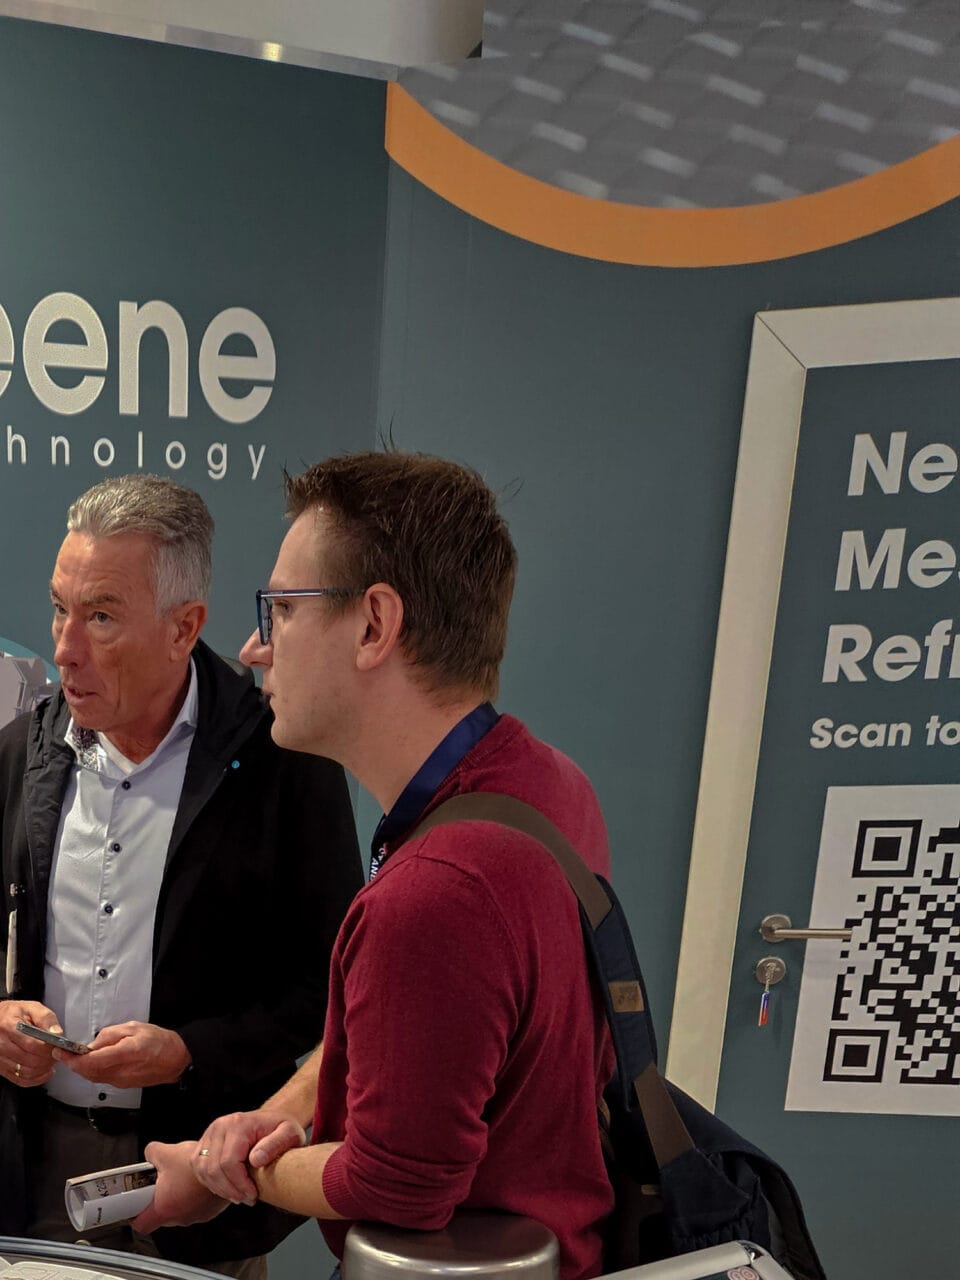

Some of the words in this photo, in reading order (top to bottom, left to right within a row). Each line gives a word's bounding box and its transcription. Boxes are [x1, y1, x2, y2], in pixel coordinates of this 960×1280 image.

[847, 431, 959, 496] Ne
[835, 528, 960, 591] Me
[809, 718, 912, 749] Scan
[926, 715, 960, 746] to
